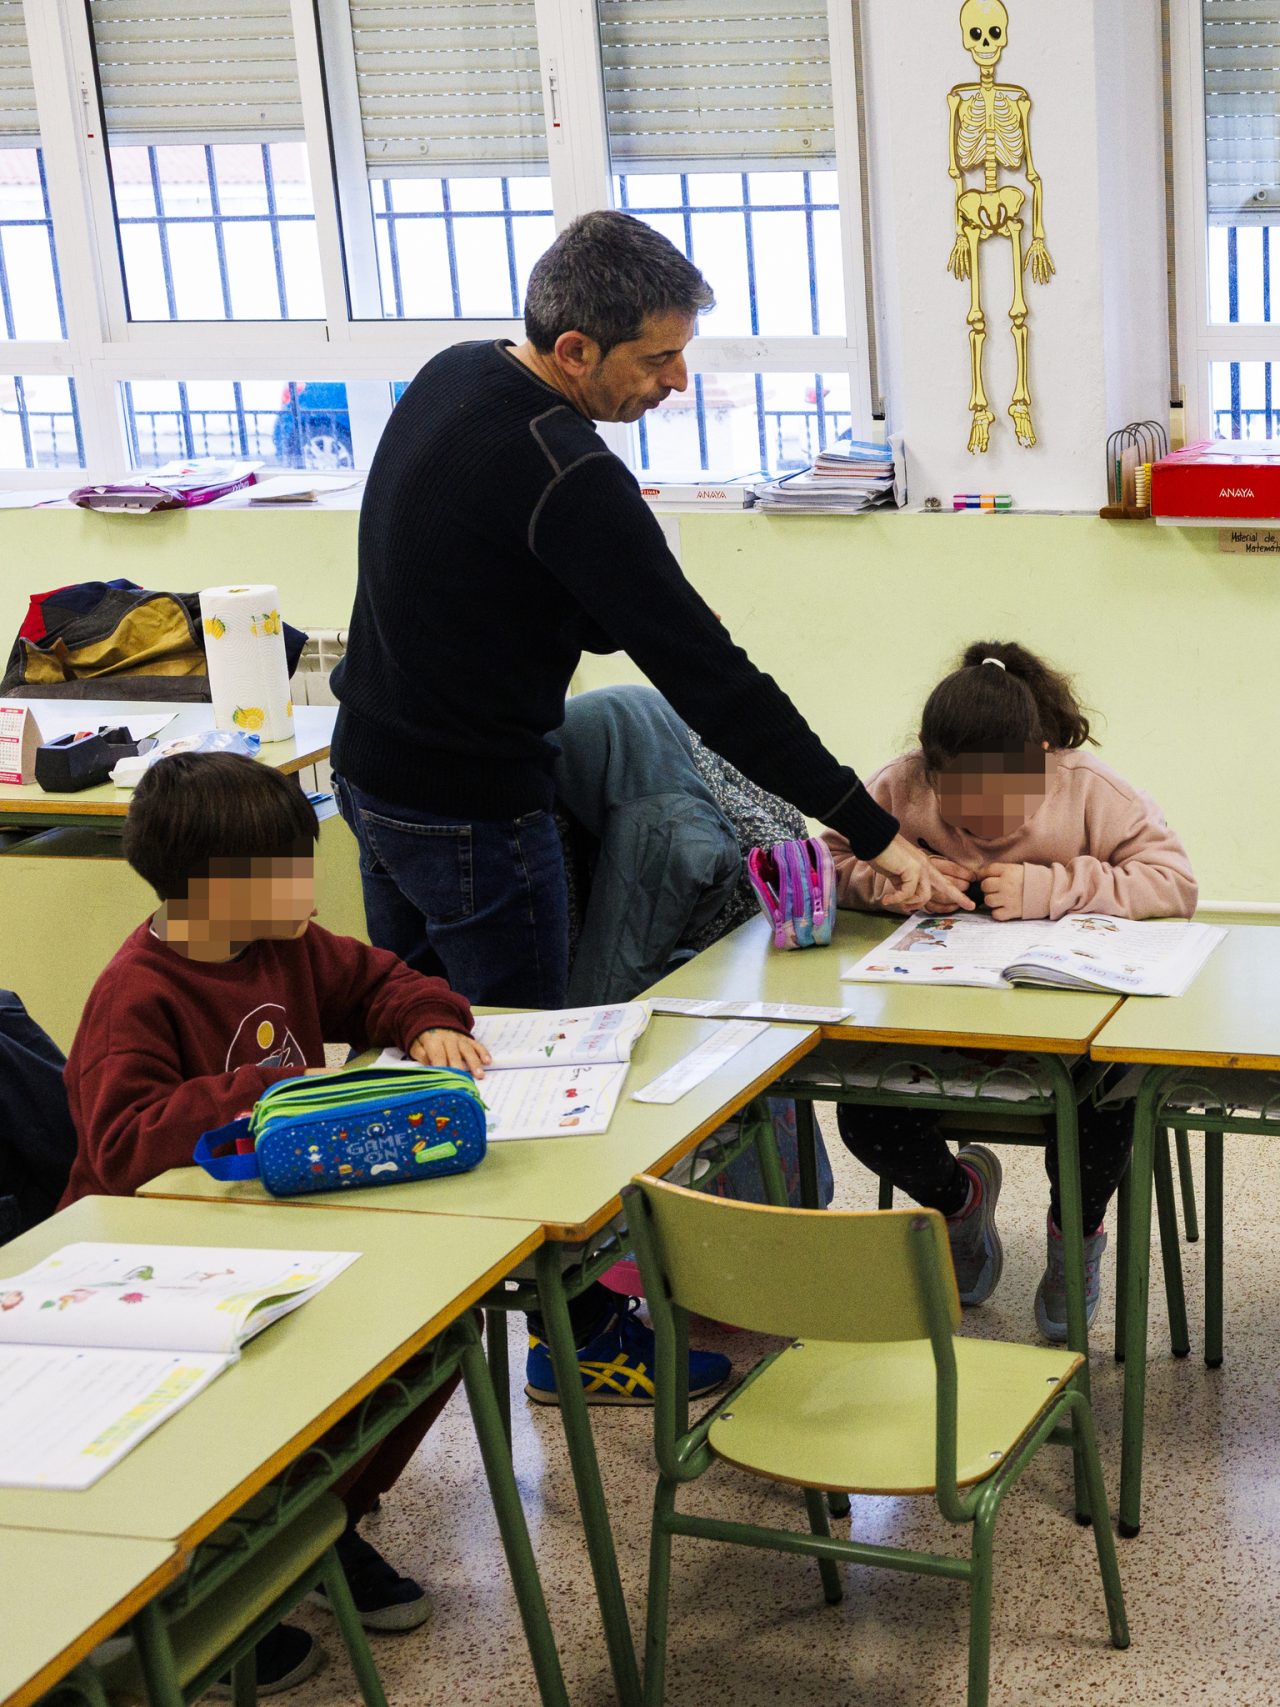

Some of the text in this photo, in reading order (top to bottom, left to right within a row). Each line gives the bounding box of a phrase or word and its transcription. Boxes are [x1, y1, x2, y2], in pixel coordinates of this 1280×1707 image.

[696, 490, 727, 499] ANAYA
[1219, 488, 1255, 498] ANAYA
[1231, 531, 1275, 542] Material de
[346, 1132, 408, 1156] GAME
[363, 1148, 400, 1164] ON
